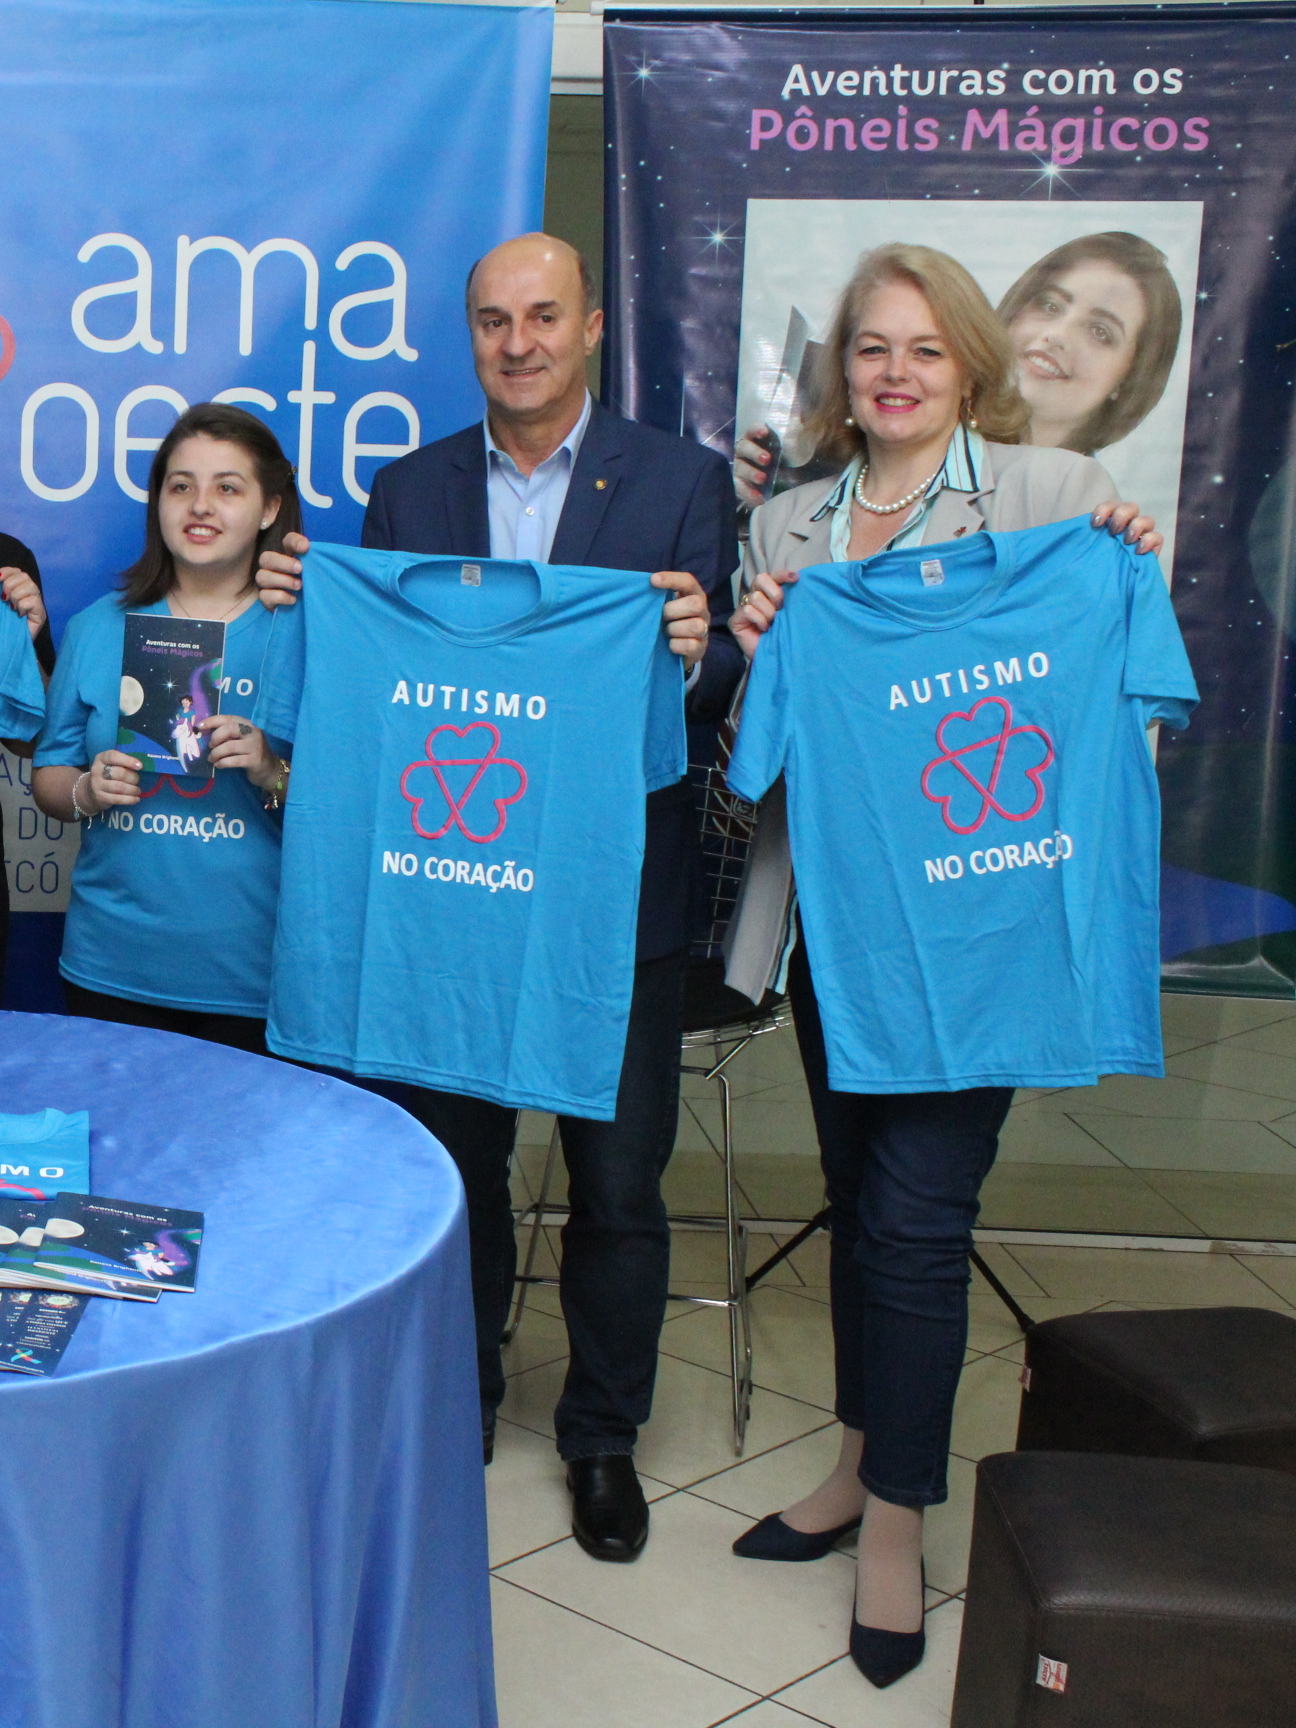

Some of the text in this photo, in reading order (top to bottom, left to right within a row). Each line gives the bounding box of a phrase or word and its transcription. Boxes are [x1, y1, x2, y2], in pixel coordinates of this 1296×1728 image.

[781, 62, 1184, 97] Aventuras com os
[749, 105, 1211, 166] Pôneis Mágicos
[70, 231, 420, 363] ama
[20, 339, 422, 510] oete
[390, 679, 547, 721] AUTISMO
[888, 651, 1050, 711] AUTISMO
[107, 810, 246, 843] NO CORAÇÃO
[381, 850, 535, 893] NO CORAÇÃO
[923, 854, 965, 883] NO
